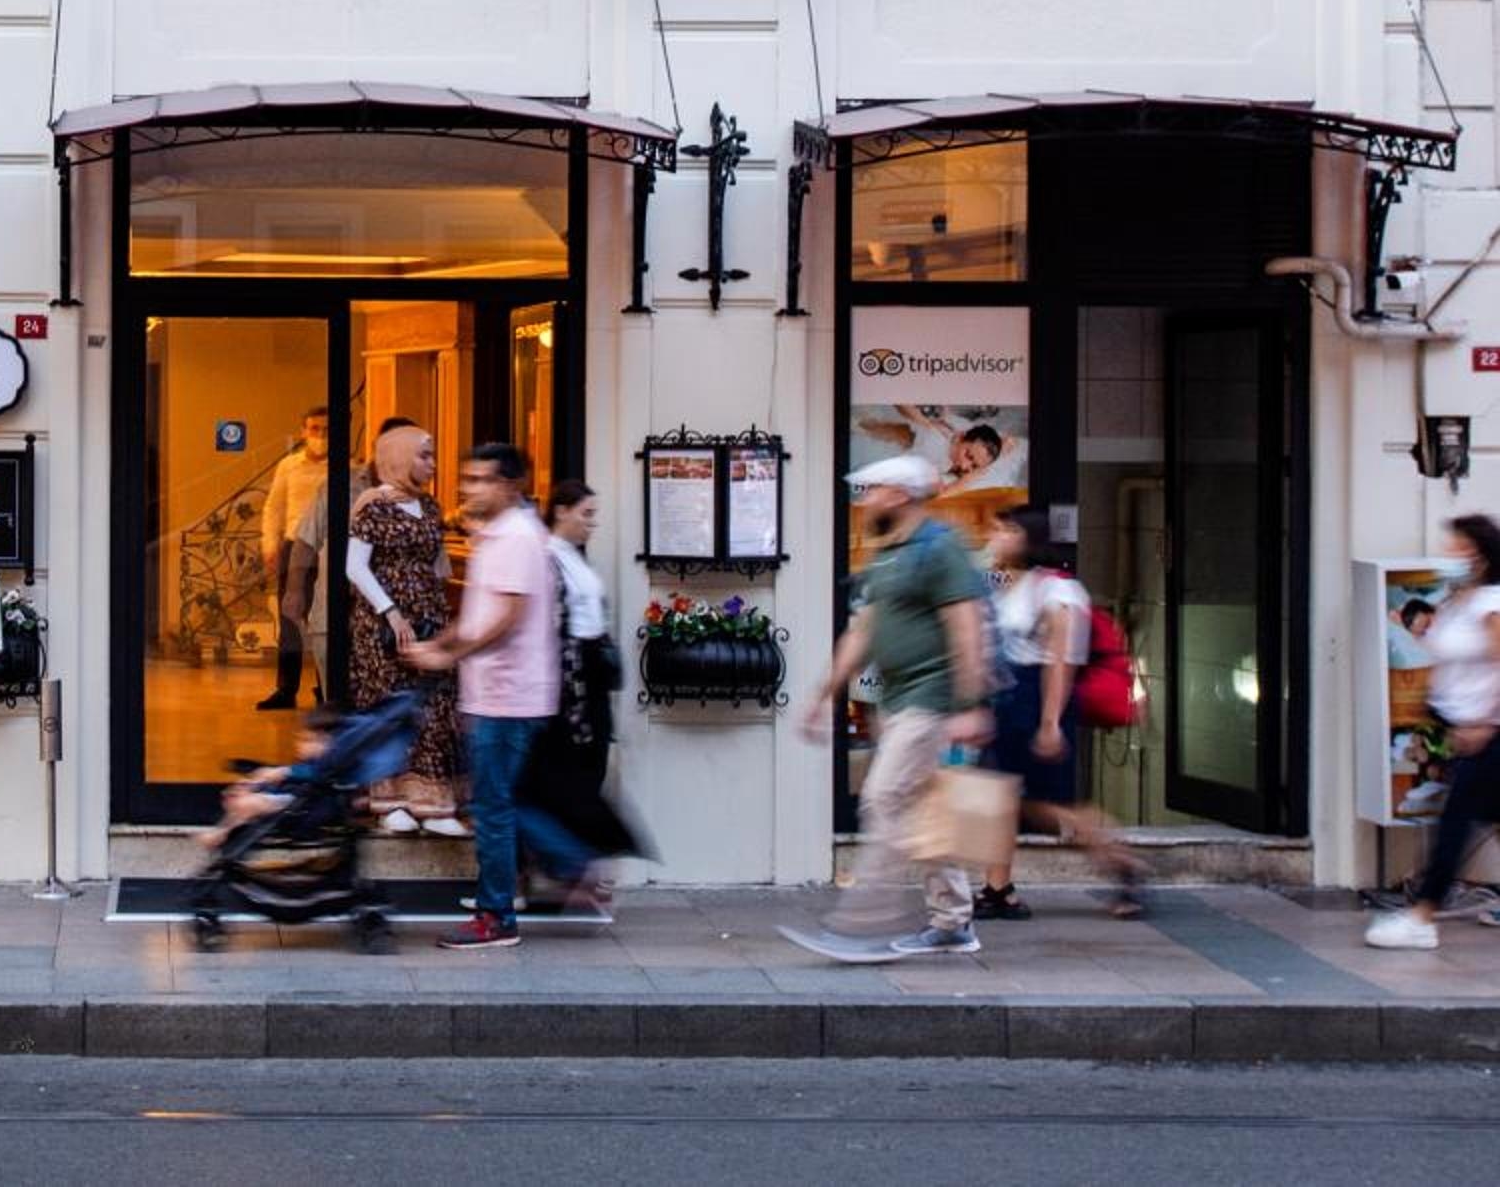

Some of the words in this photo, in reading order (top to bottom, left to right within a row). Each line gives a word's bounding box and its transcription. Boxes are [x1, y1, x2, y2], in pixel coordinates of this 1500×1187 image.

[22, 319, 39, 333] 24
[909, 352, 1017, 376] tripadvisor
[1480, 350, 1499, 366] 22
